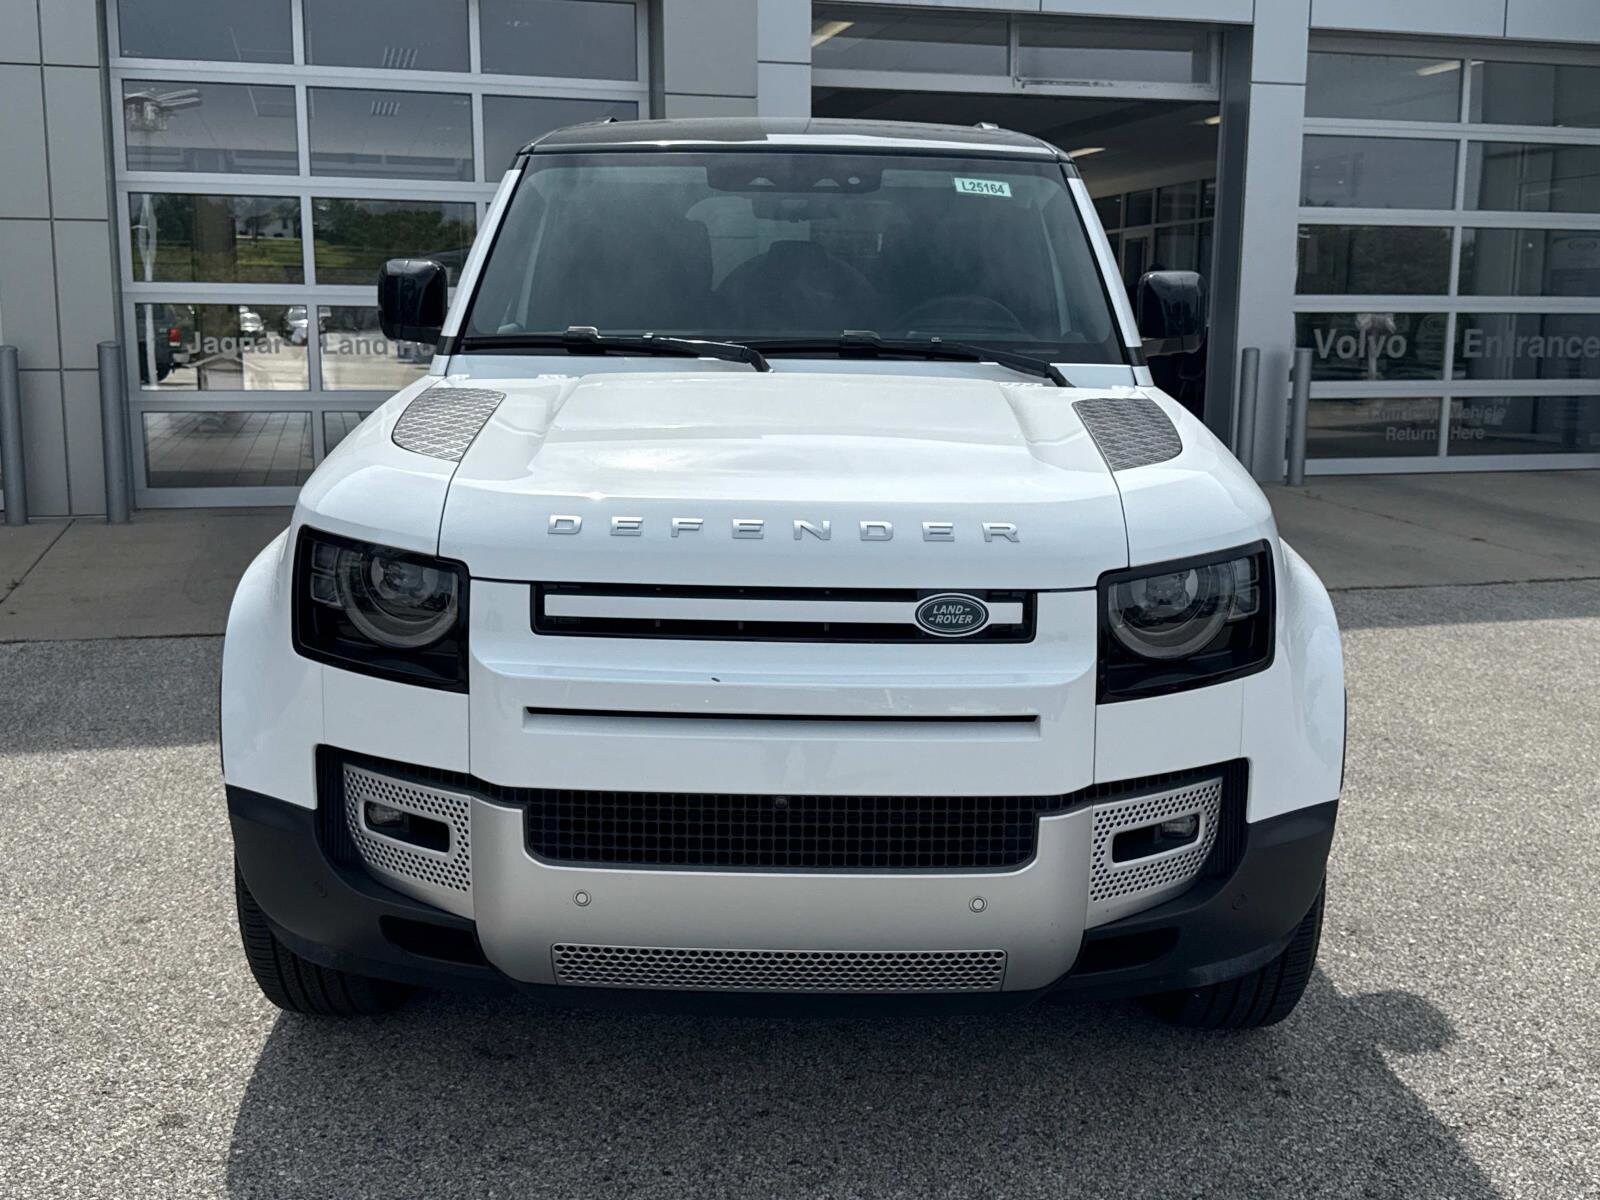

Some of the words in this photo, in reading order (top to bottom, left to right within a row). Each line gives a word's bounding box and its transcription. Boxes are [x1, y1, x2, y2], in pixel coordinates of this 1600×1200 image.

[961, 181, 1005, 194] L25164
[187, 331, 284, 358] Jaguar
[322, 333, 388, 355] Land
[1314, 328, 1407, 359] Volvo
[1463, 328, 1600, 359] Entrance
[1386, 426, 1436, 441] Return
[1450, 425, 1486, 440] Here
[547, 514, 1020, 543] DEFENDER
